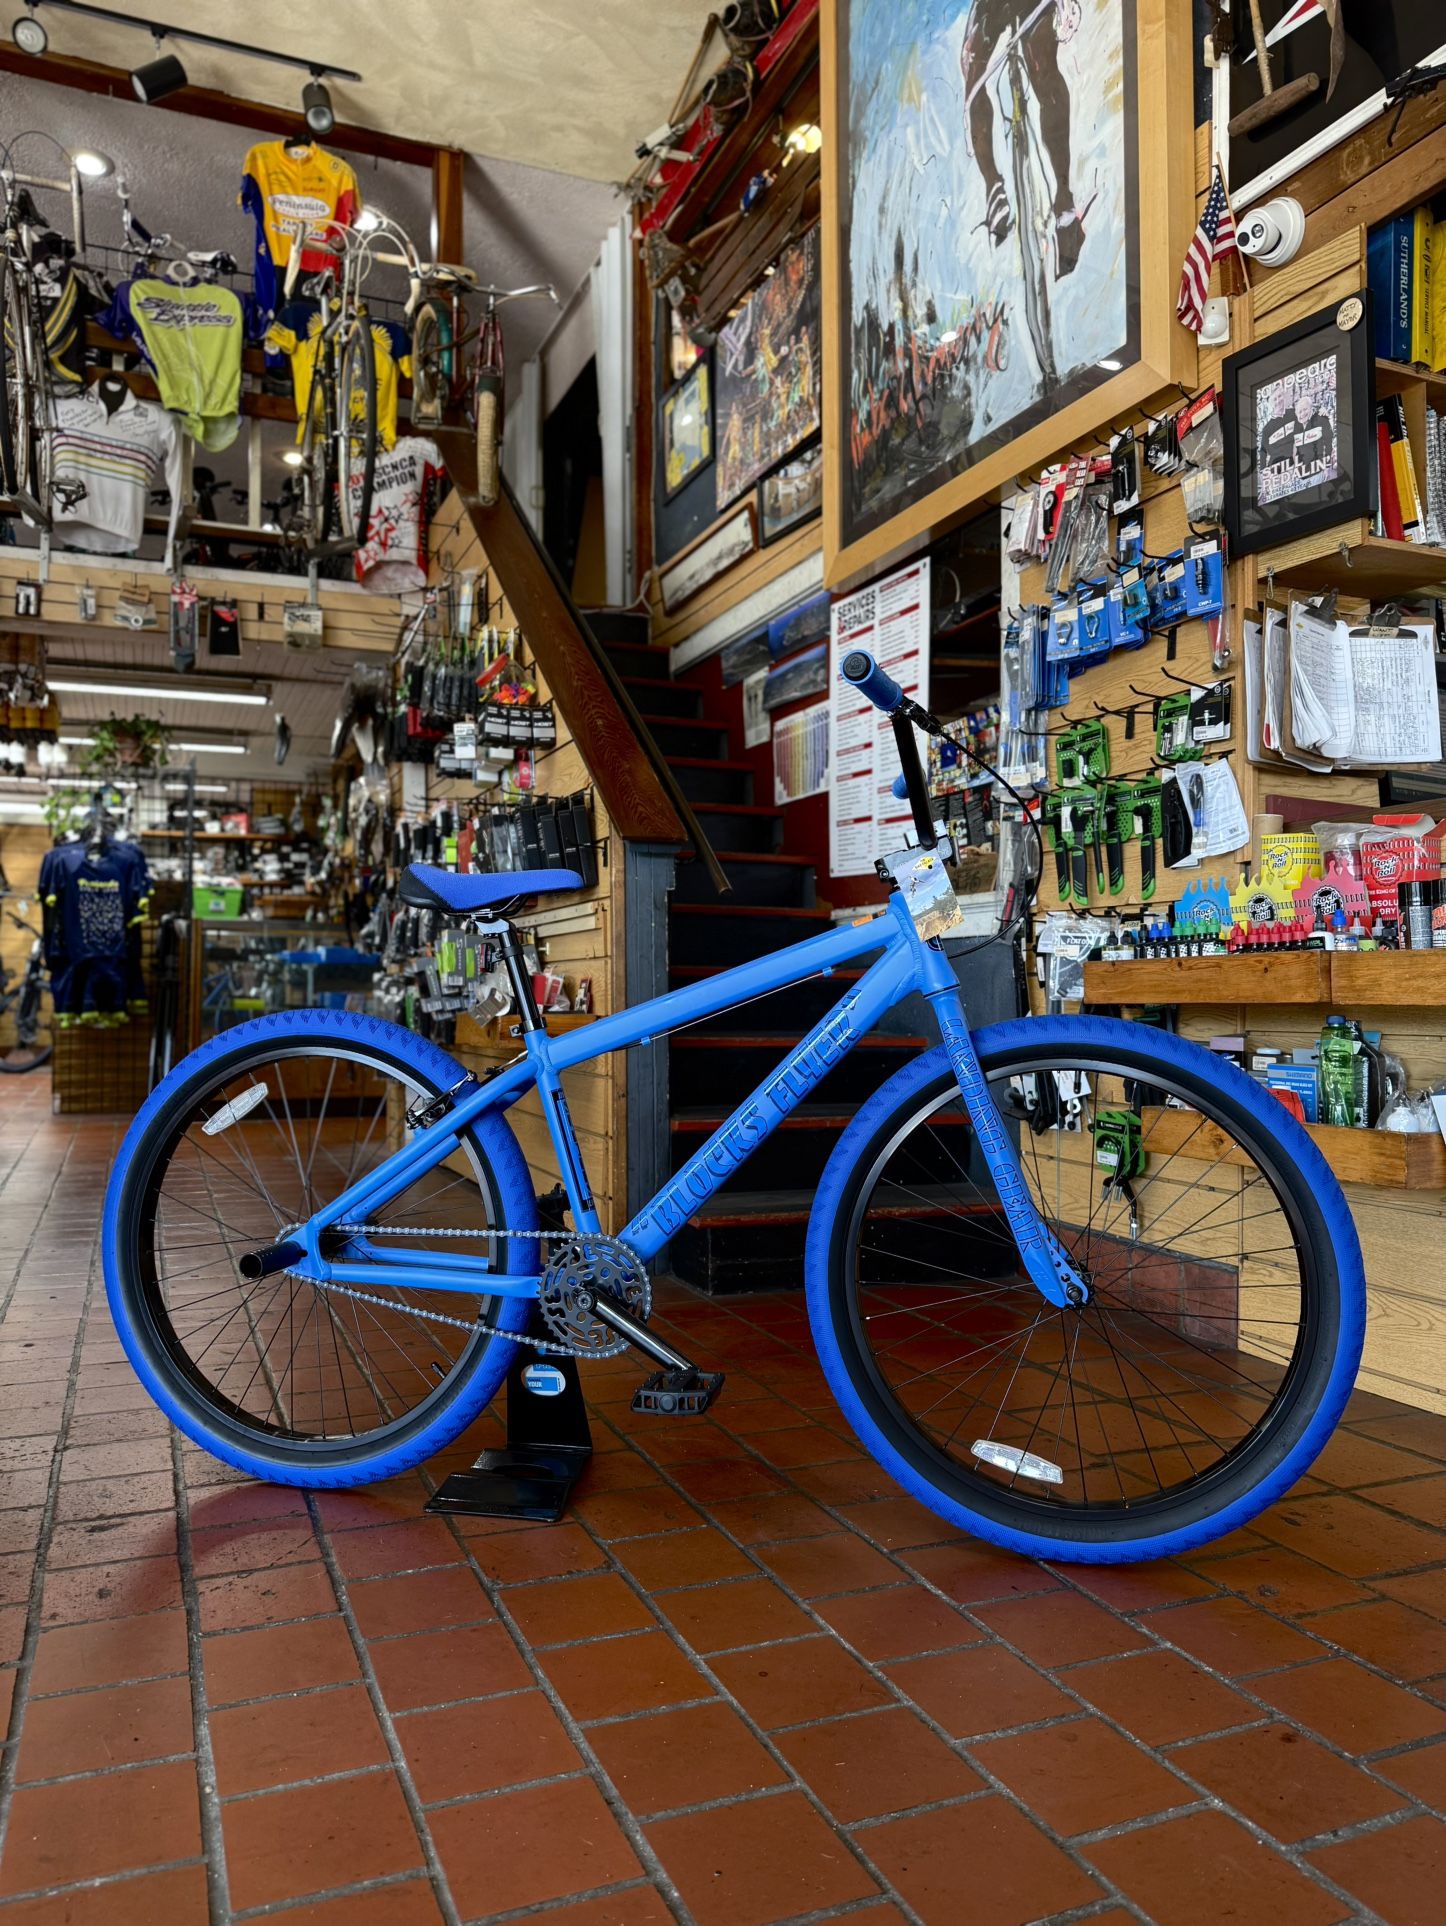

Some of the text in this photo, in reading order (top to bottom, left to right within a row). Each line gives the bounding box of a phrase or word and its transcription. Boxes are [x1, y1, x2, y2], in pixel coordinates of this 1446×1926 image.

[1400, 235, 1409, 329] SUTHERLAND'S
[1262, 455, 1304, 479] STILL
[1262, 455, 1332, 490] PEDALIN'
[351, 469, 418, 499] CMPION
[838, 590, 876, 616] SERVICES
[844, 606, 876, 632] REPAIRS
[1270, 851, 1288, 860] Rock
[1272, 860, 1287, 869] Roll
[1375, 856, 1398, 867] Rock
[1377, 867, 1395, 877] Roll
[1315, 893, 1338, 905] Rock
[1370, 899, 1398, 908] BSOLU
[1251, 900, 1270, 911] Rock
[1320, 905, 1336, 915] Roll
[1195, 908, 1216, 917] Rock
[1255, 911, 1271, 921] Roll
[1380, 908, 1396, 916] DRY
[1286, 1071, 1313, 1079] SHIMANO
[941, 1018, 1042, 1254] LANDING GEAR
